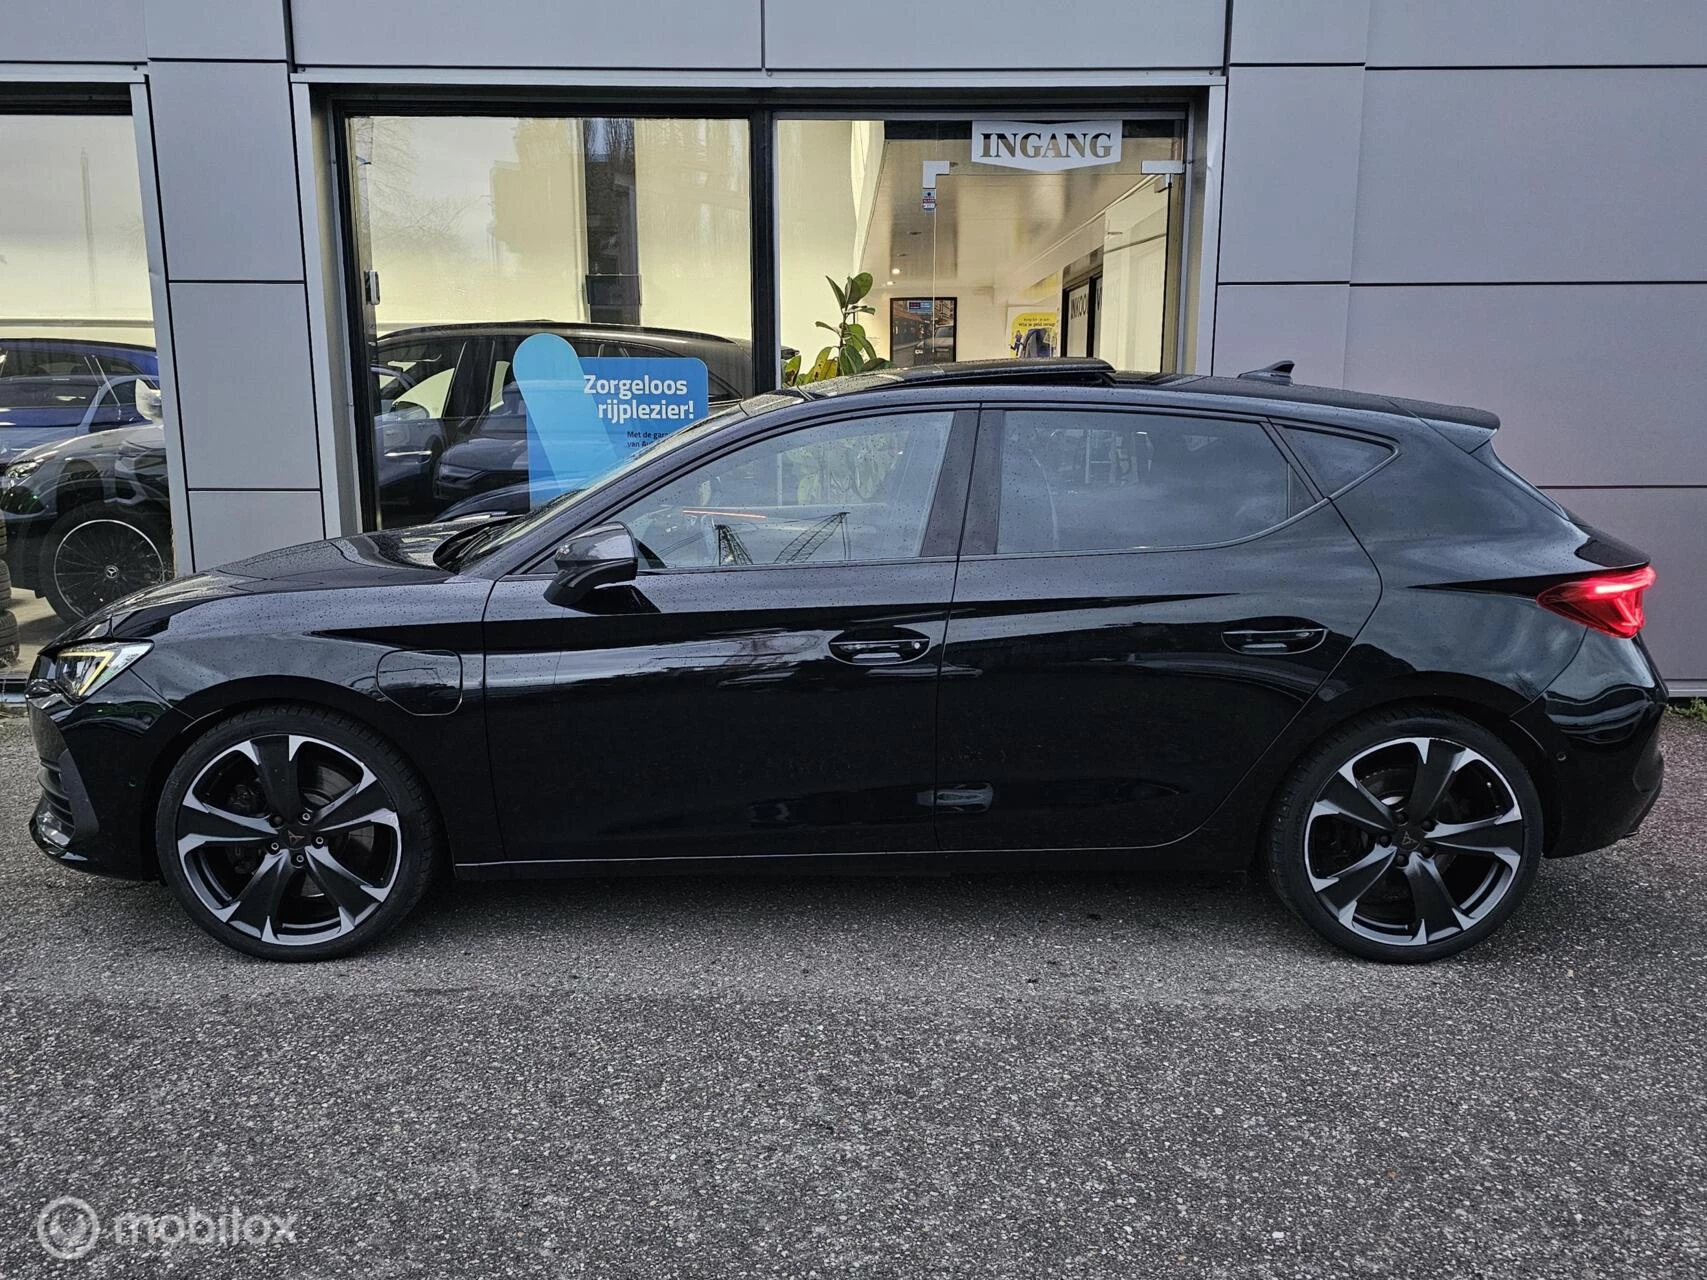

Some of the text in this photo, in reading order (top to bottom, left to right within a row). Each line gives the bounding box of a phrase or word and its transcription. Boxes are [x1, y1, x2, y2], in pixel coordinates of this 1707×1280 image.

[980, 132, 1112, 159] INGANG
[583, 374, 688, 399] Zorgeloos
[598, 400, 694, 424] rijplezier!
